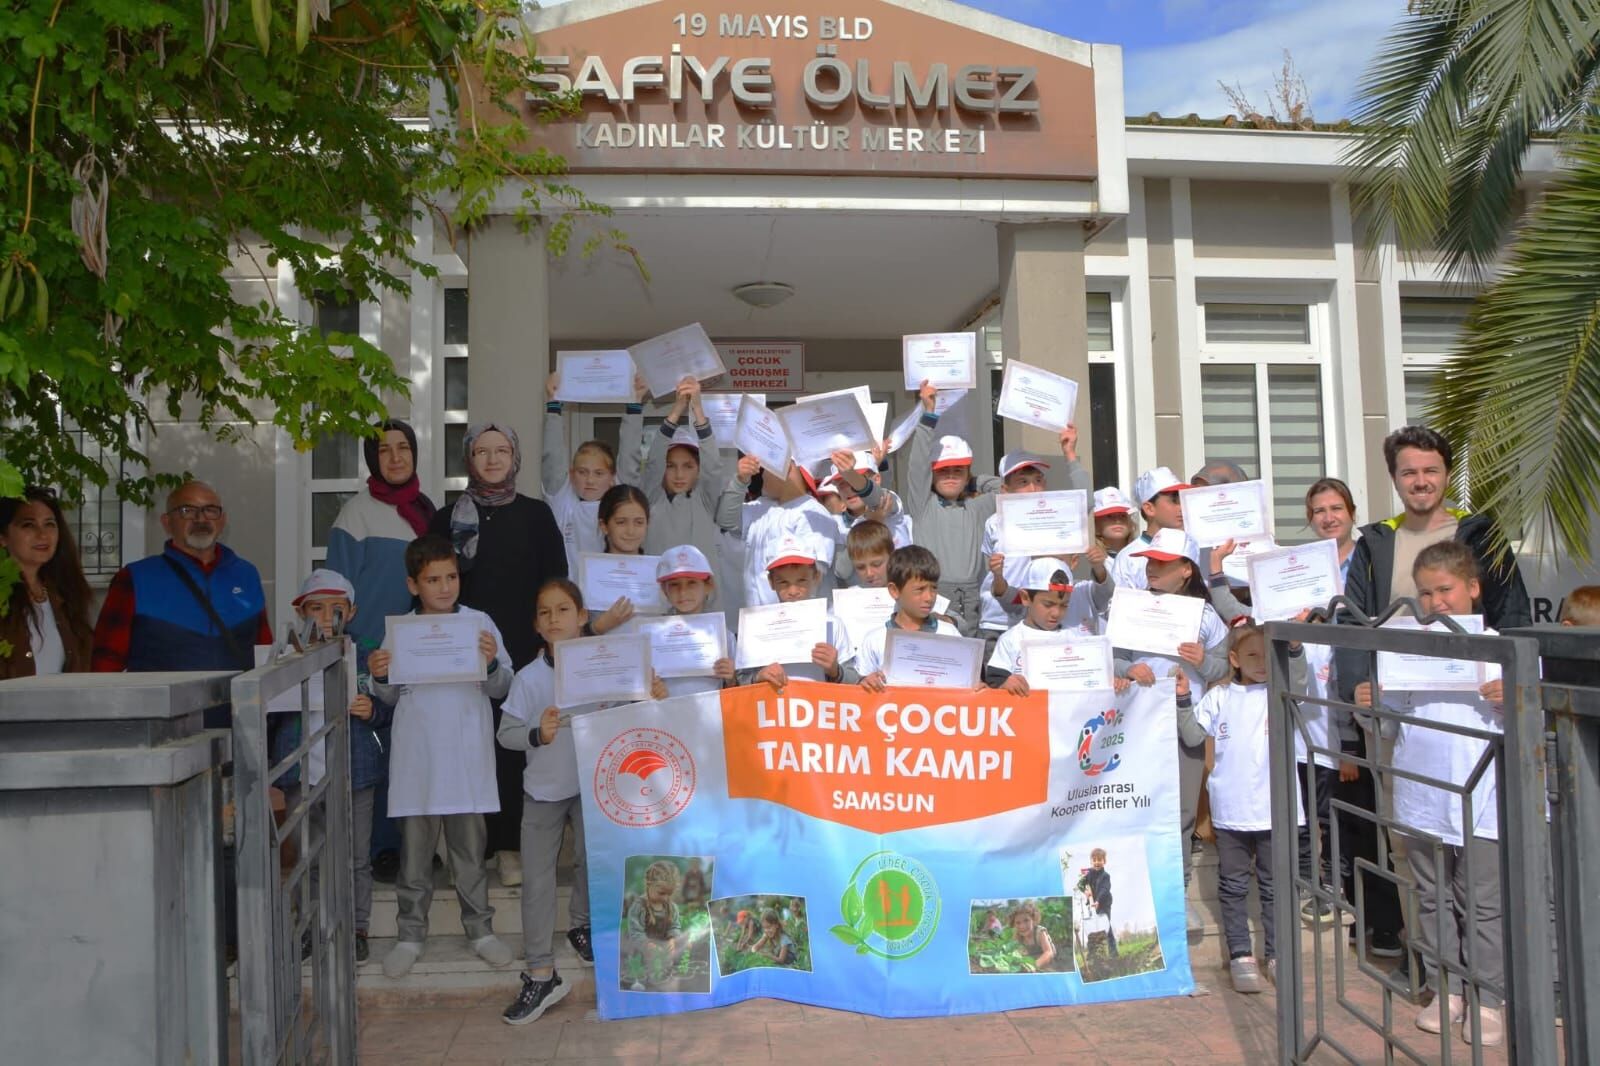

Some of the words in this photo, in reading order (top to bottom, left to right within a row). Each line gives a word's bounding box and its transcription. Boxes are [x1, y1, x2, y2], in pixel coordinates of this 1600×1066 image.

[672, 13, 707, 37] 19
[719, 14, 809, 39] MAYIS
[819, 16, 873, 40] BLD
[525, 43, 773, 103] SAFİYE
[803, 44, 1041, 112] ÖLMEZ
[575, 123, 726, 149] KADINLAR
[737, 118, 850, 151] KÜLTÜR
[861, 125, 986, 154] MERKEZİ
[738, 357, 781, 366] ÇOCUK
[733, 378, 787, 388] MERKEZİ
[876, 703, 1016, 742] ÇOCUK
[1101, 733, 1124, 749] 2025
[757, 741, 871, 775] TARIM
[886, 746, 1013, 780] KAMPI
[832, 790, 934, 813] SAMSUN
[1067, 783, 1134, 801] Uluslararası
[1051, 796, 1128, 818] Kooperatifler
[1131, 795, 1151, 808] Yılı
